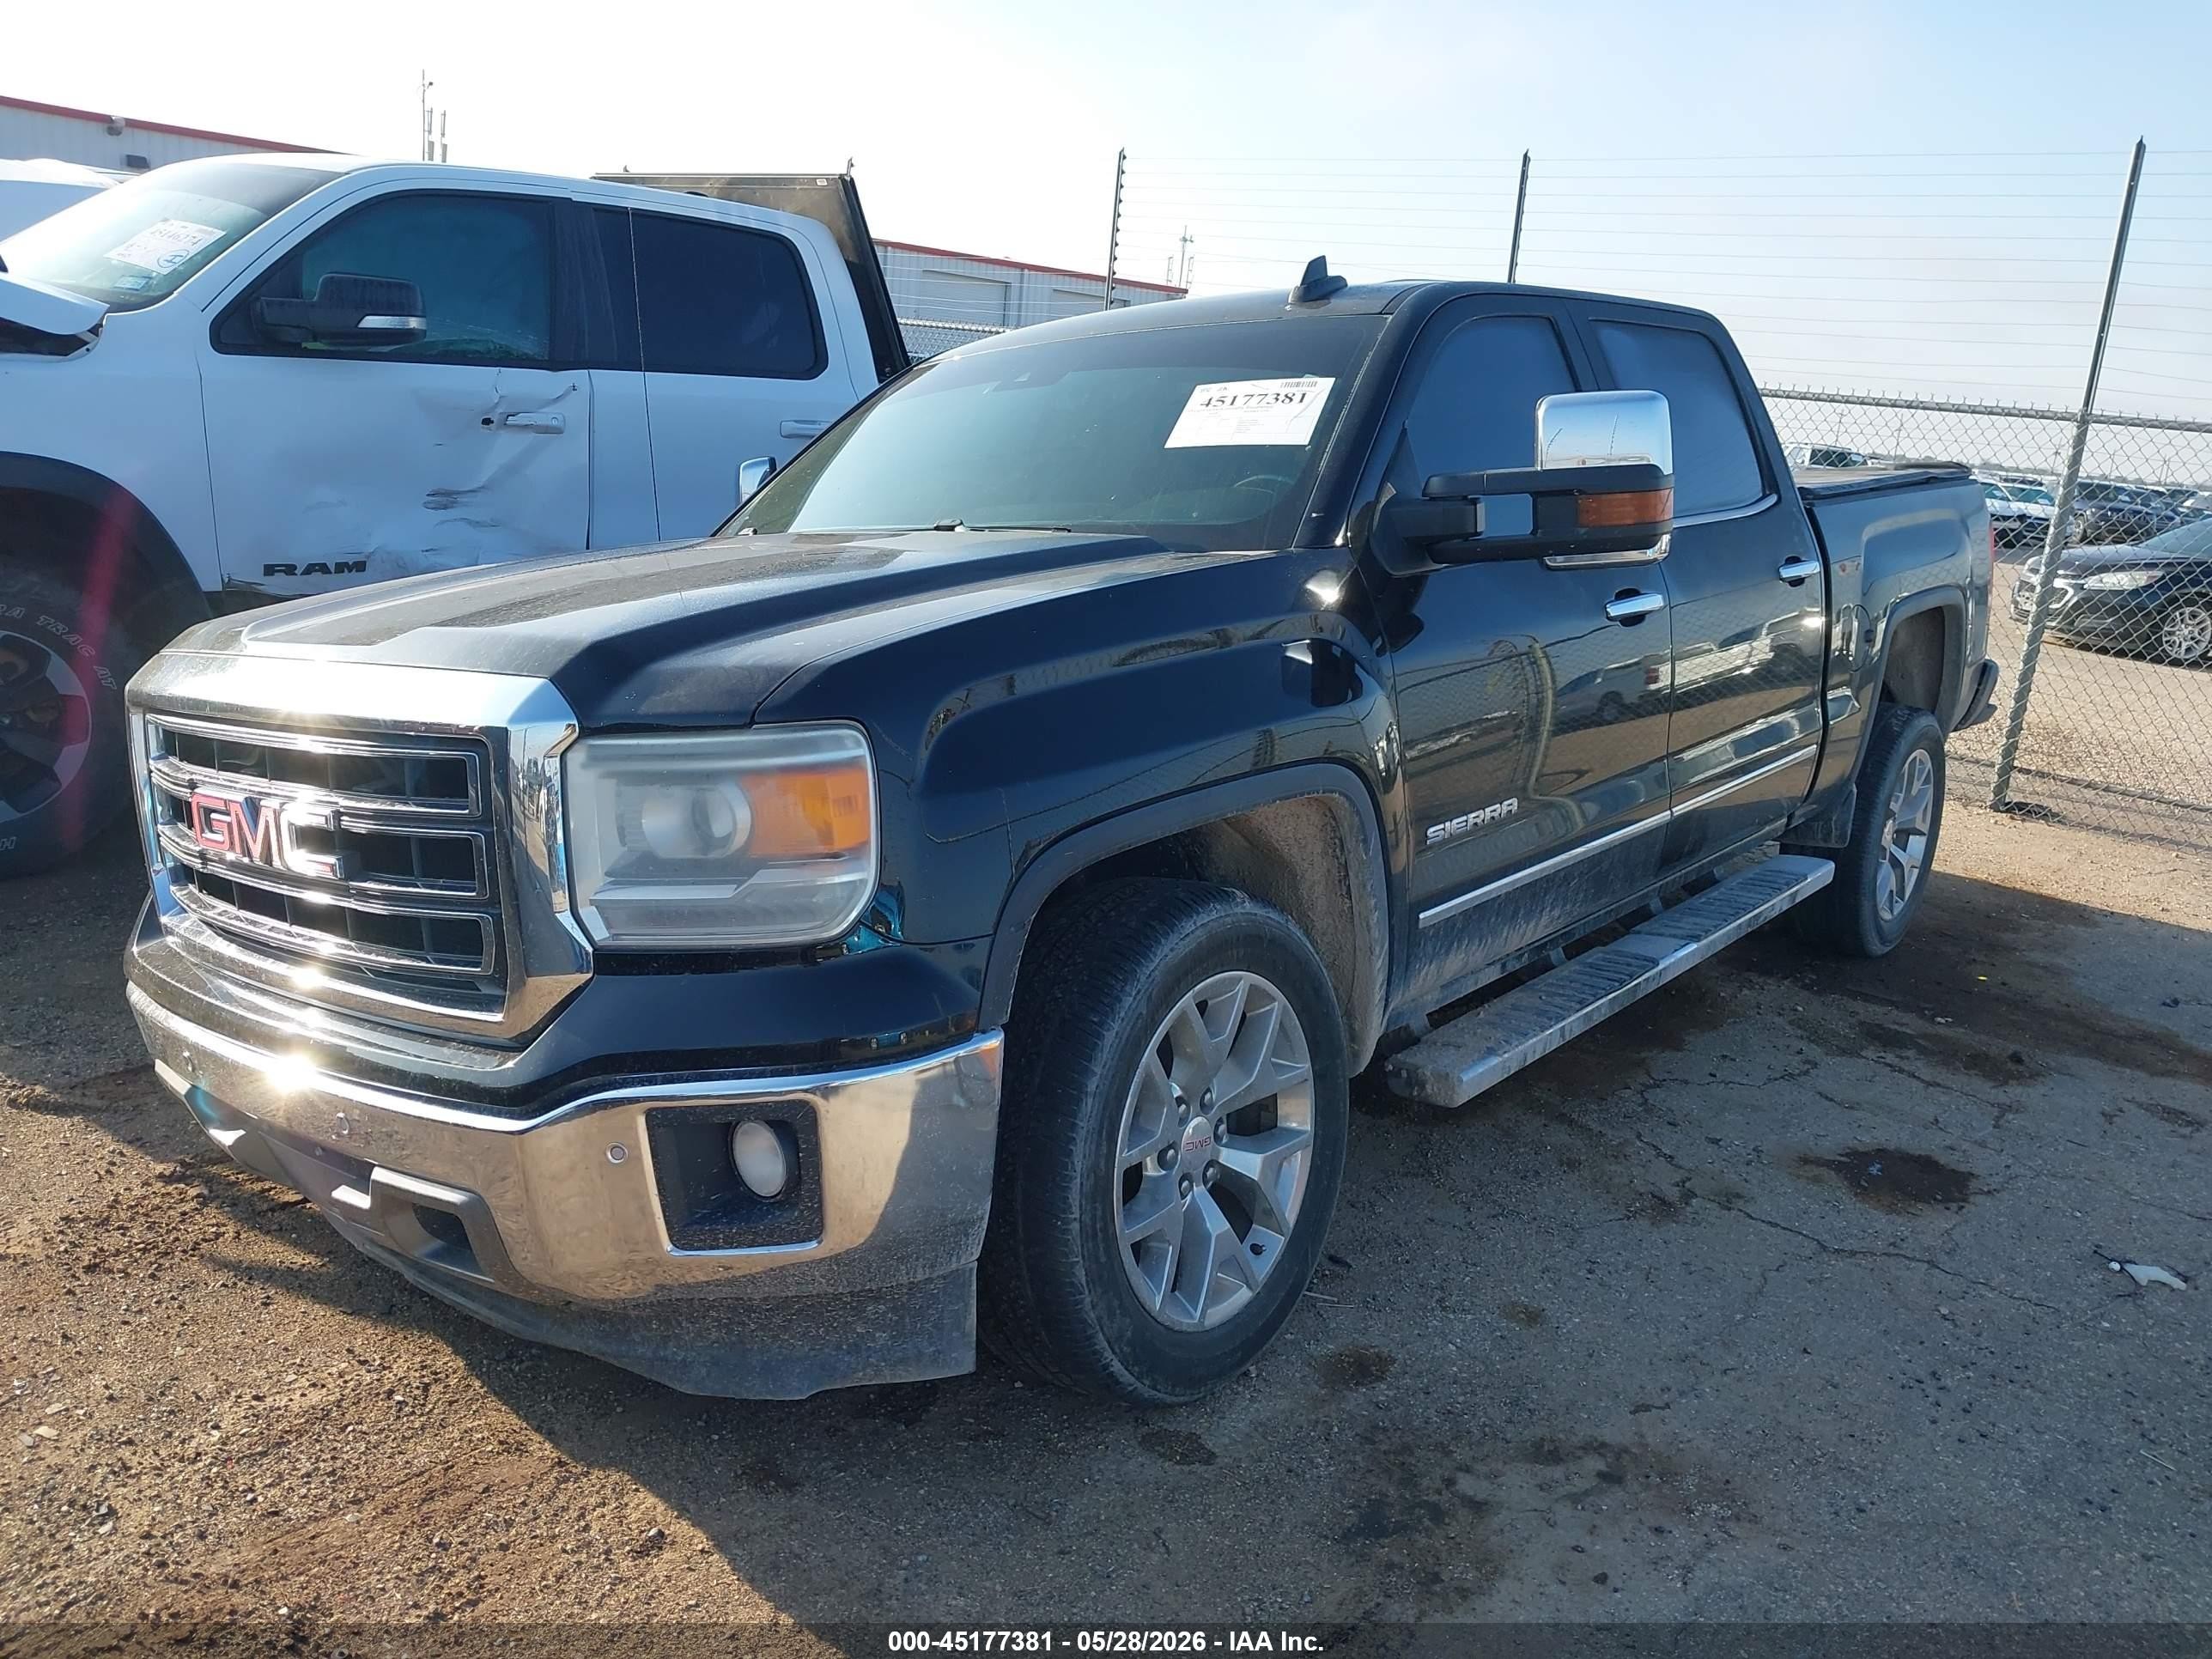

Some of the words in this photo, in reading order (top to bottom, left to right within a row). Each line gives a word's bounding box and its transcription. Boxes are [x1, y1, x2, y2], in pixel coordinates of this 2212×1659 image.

[1200, 392, 1308, 408] 45177381
[263, 560, 367, 577] RAM
[36, 615, 96, 658] TRAC
[93, 665, 118, 690] AT
[191, 787, 344, 878] GMC
[1425, 797, 1519, 845] SIERRA
[1185, 1136, 1212, 1152] GMC
